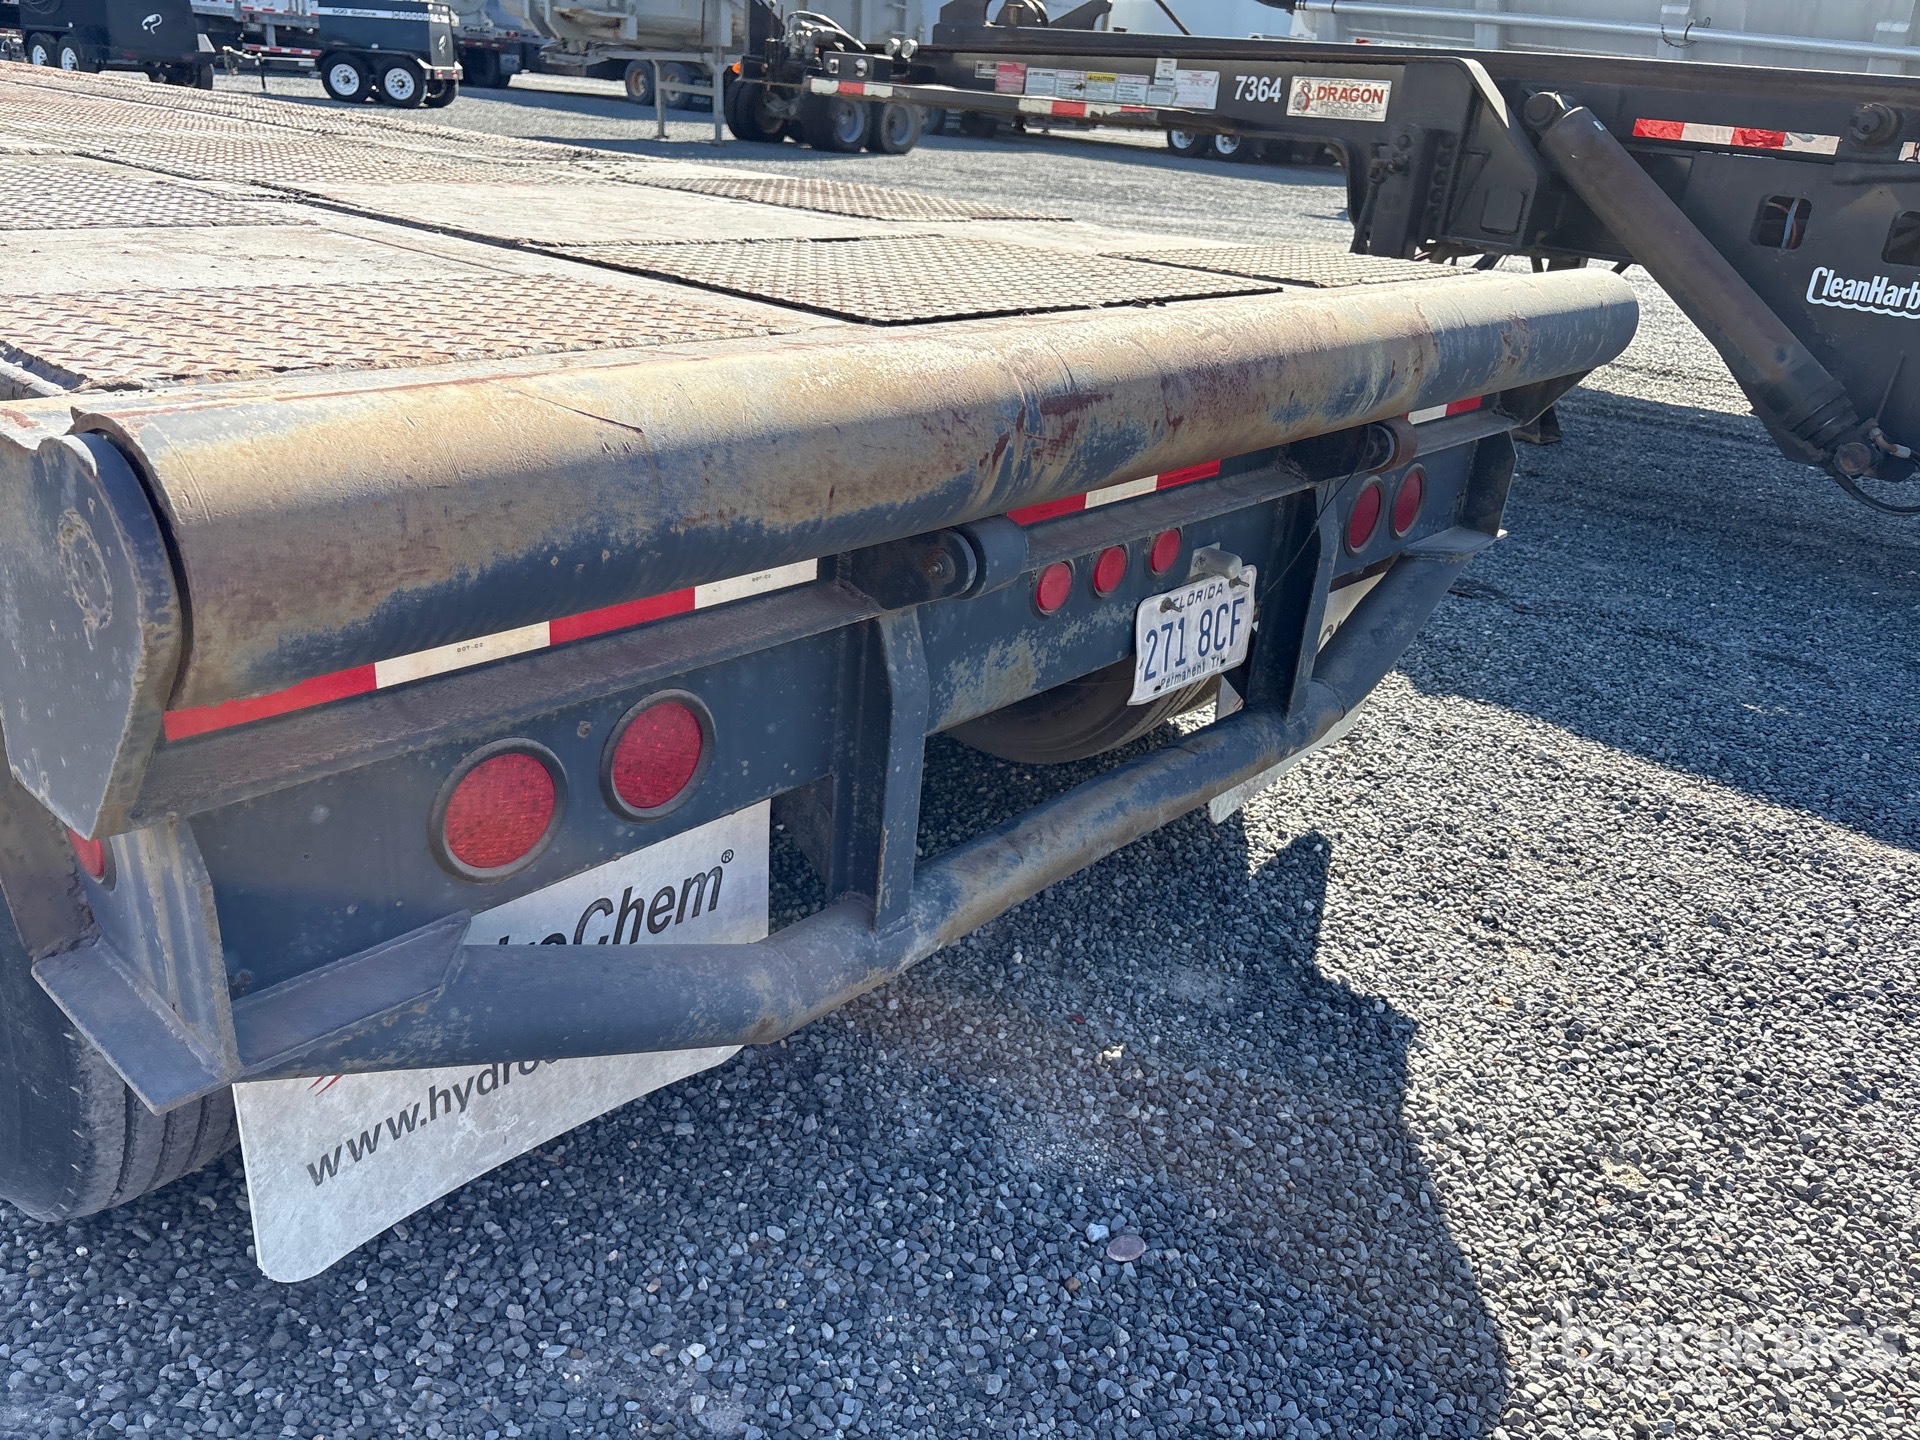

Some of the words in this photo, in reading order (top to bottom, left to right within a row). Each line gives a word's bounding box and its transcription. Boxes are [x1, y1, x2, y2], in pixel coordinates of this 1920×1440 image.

[1234, 76, 1282, 103] 7364
[1316, 86, 1385, 104] DRAGON
[456, 642, 484, 653] DOT-C2
[1144, 617, 1186, 682] 271
[1198, 597, 1245, 657] 8CF
[1160, 661, 1205, 688] Permanent
[306, 1059, 559, 1187] www.hydro
